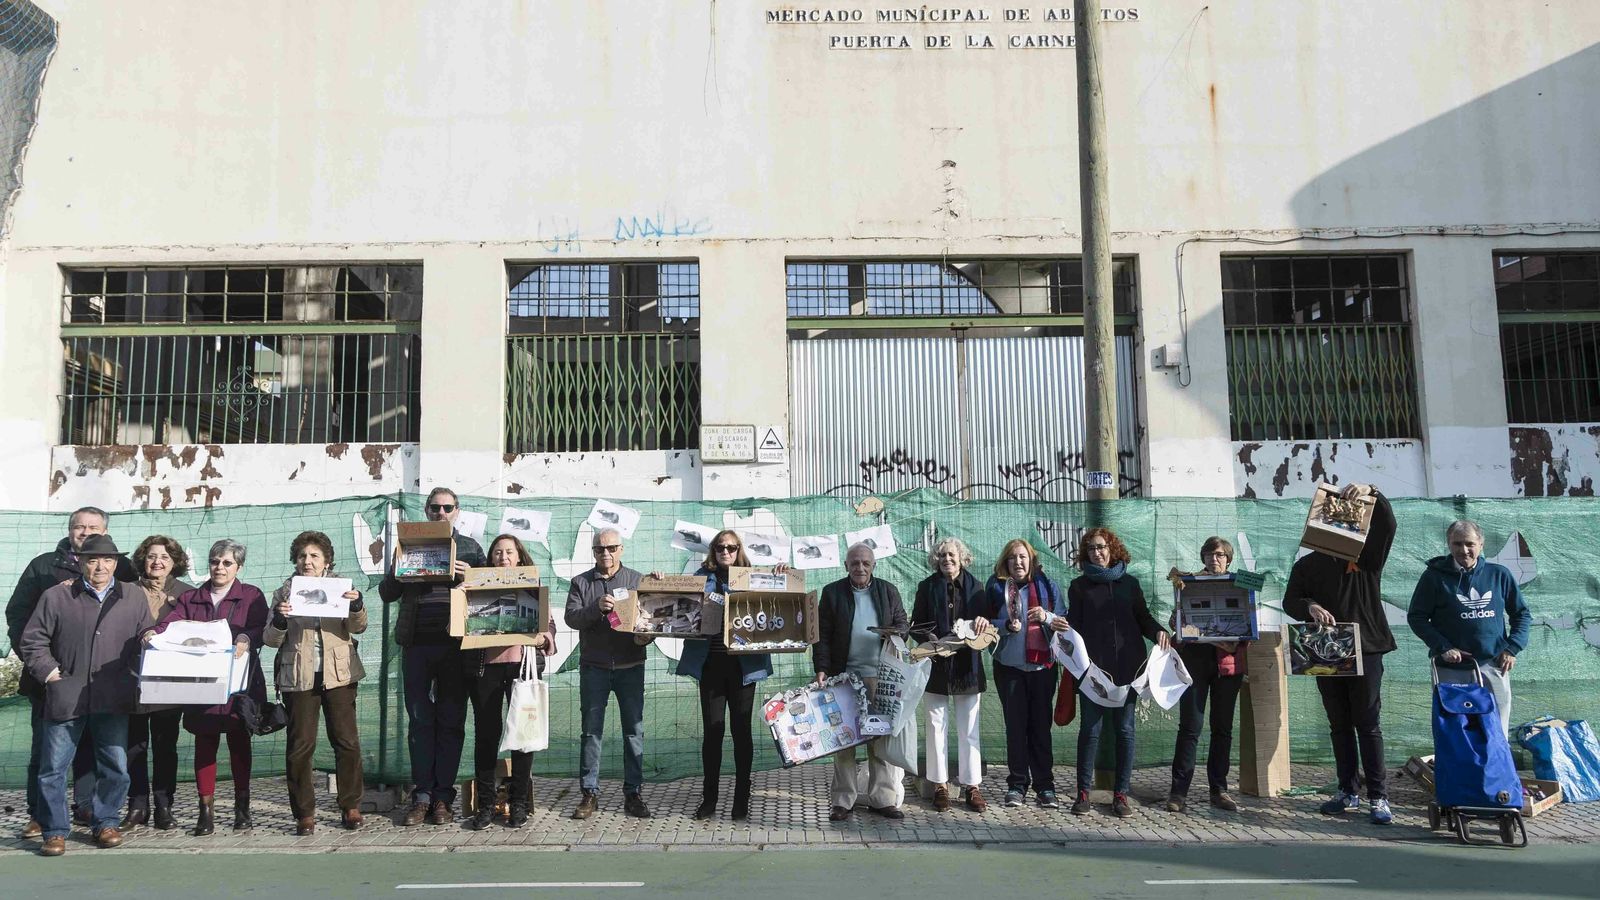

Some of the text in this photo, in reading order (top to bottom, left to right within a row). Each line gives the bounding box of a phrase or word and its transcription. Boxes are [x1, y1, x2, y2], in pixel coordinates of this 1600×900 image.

[767, 9, 863, 22] MERCADO
[1005, 8, 1031, 21] DE
[1046, 8, 1139, 21] ABTOS
[830, 35, 1076, 48] PUERTA DE LA CARNE
[1460, 609, 1495, 619] adidas
